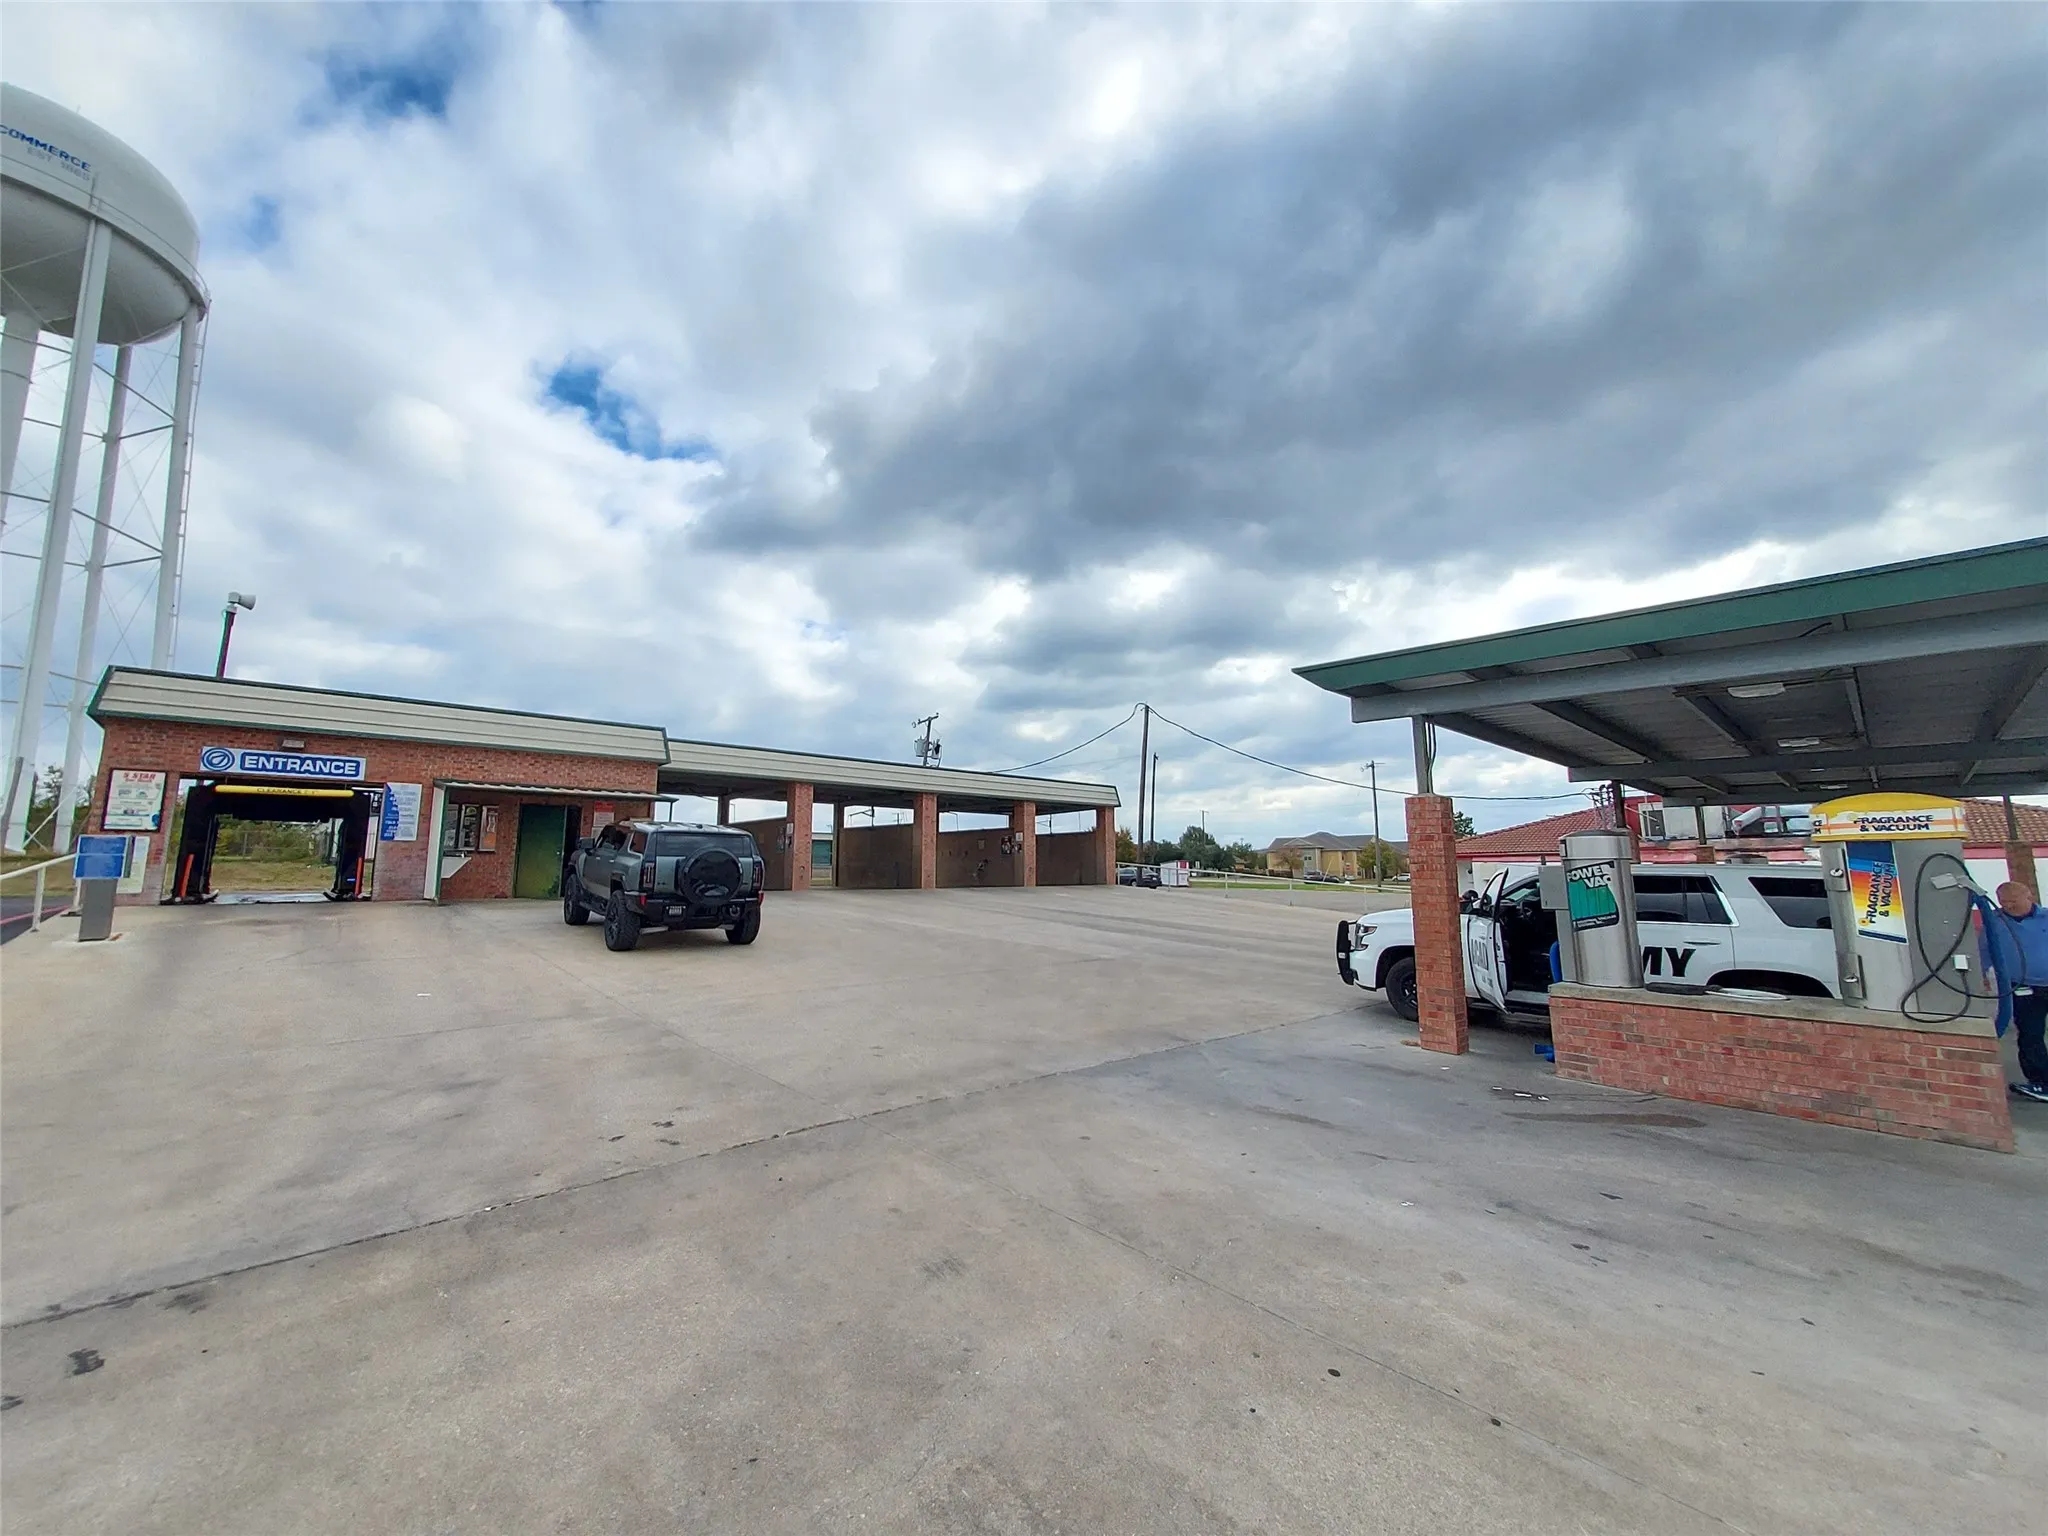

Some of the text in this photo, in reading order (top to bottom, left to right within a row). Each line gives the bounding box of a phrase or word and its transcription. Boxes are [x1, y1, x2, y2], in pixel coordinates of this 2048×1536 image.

[0, 124, 91, 172] COMMERCE
[244, 755, 357, 775] ENTRANCE
[132, 772, 157, 780] STAR
[256, 787, 302, 796] CLEARANCE
[1853, 815, 1934, 824] FRAGRANCE
[1859, 823, 1930, 832] & VACUUM
[1583, 874, 1612, 888] VAC
[1866, 861, 1883, 924] FRAGRANCE
[1879, 863, 1895, 918] & VACUUM
